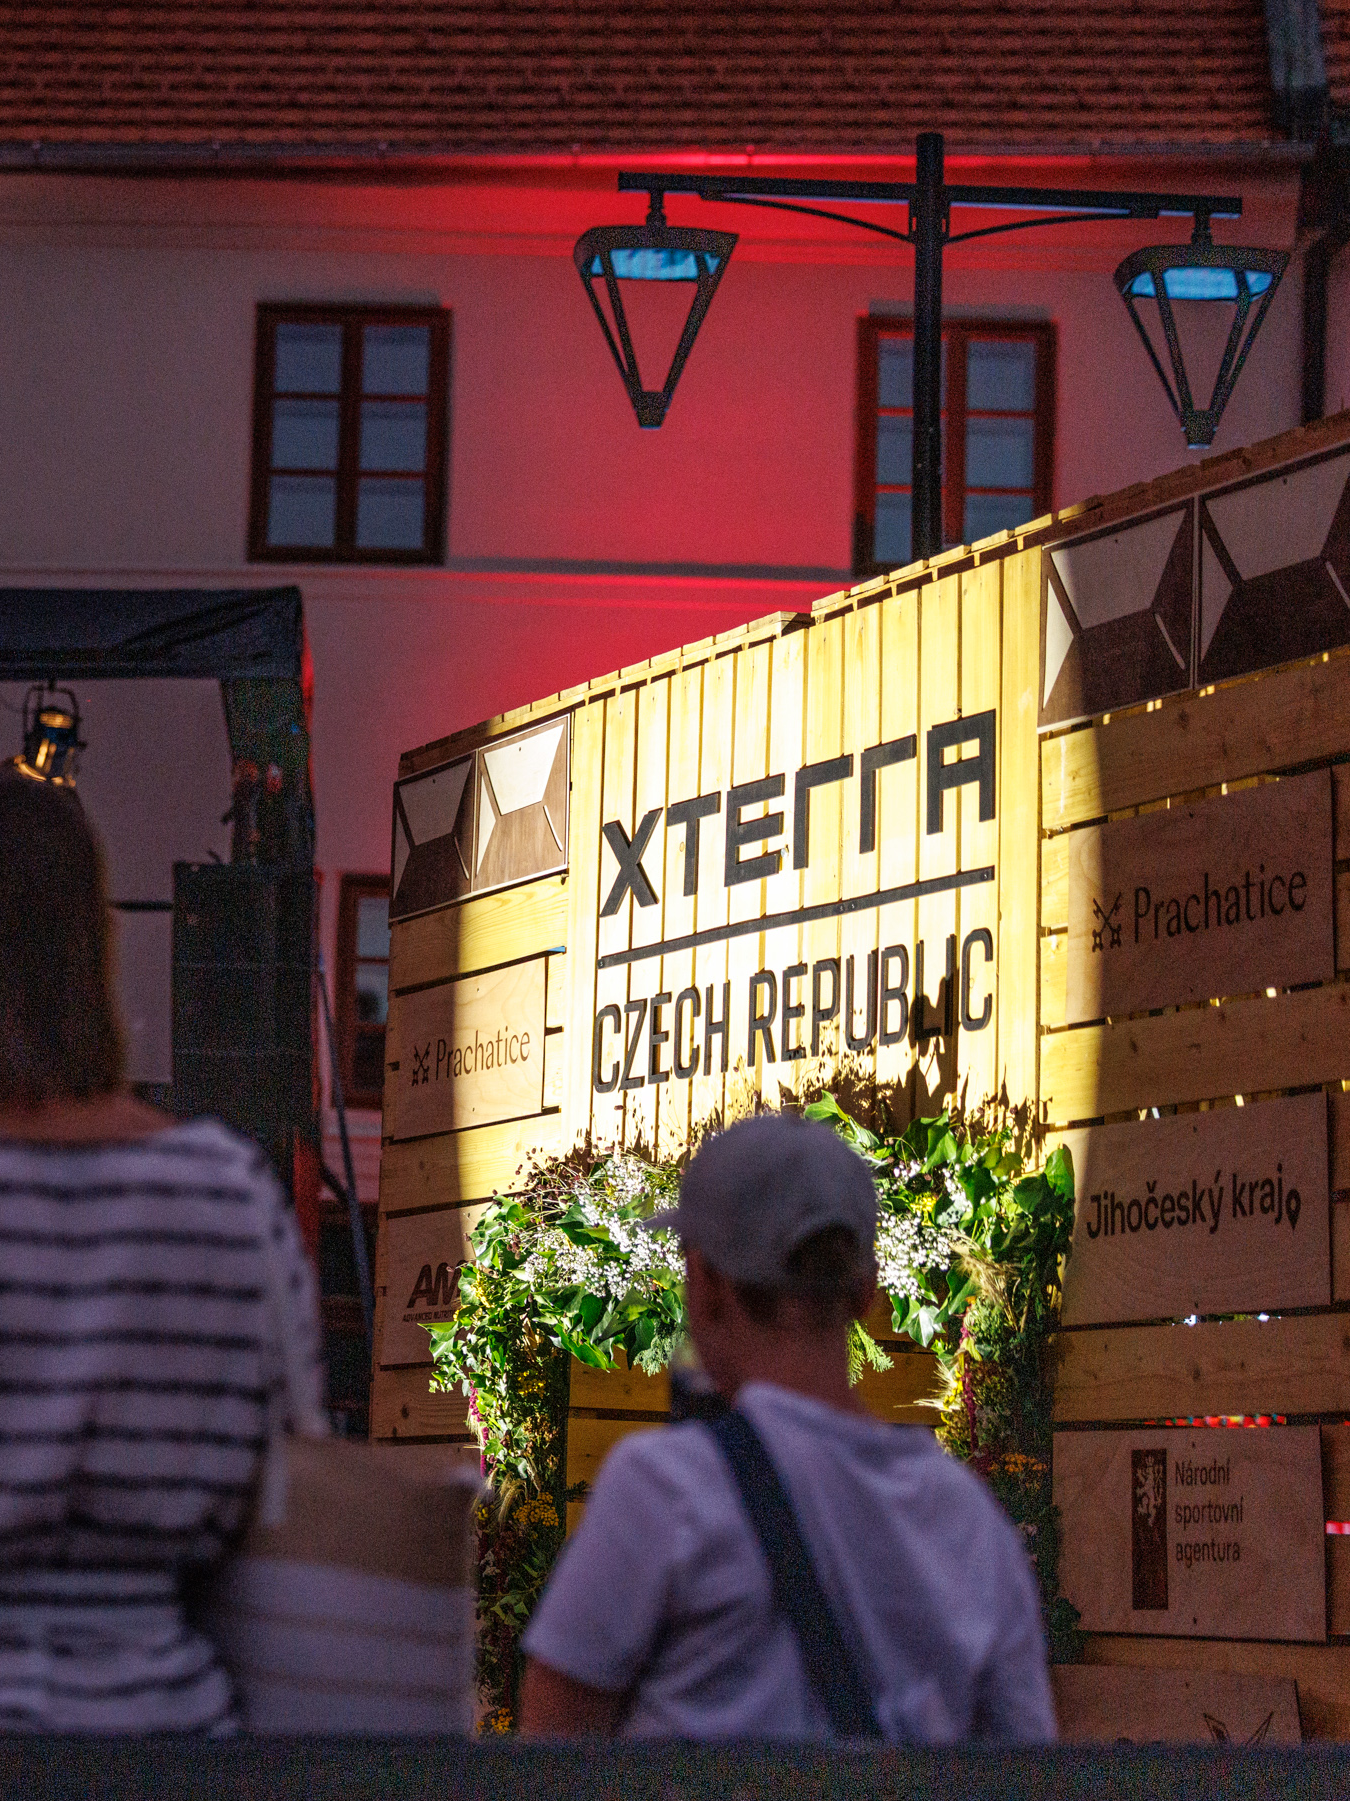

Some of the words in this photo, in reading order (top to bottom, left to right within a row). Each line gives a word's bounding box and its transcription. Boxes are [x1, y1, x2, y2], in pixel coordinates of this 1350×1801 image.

[1134, 864, 1308, 944] Prachatice
[593, 980, 731, 1094] CZECH
[747, 927, 994, 1068] REPUBLIC
[436, 1026, 530, 1081] Prachatice
[1087, 1169, 1224, 1240] Jihočeský
[1232, 1163, 1284, 1225] kraj
[403, 1312, 432, 1322] ADVANCED
[1175, 1457, 1230, 1486] Národní
[1175, 1496, 1244, 1531] sportovní
[1175, 1538, 1240, 1568] agentura
